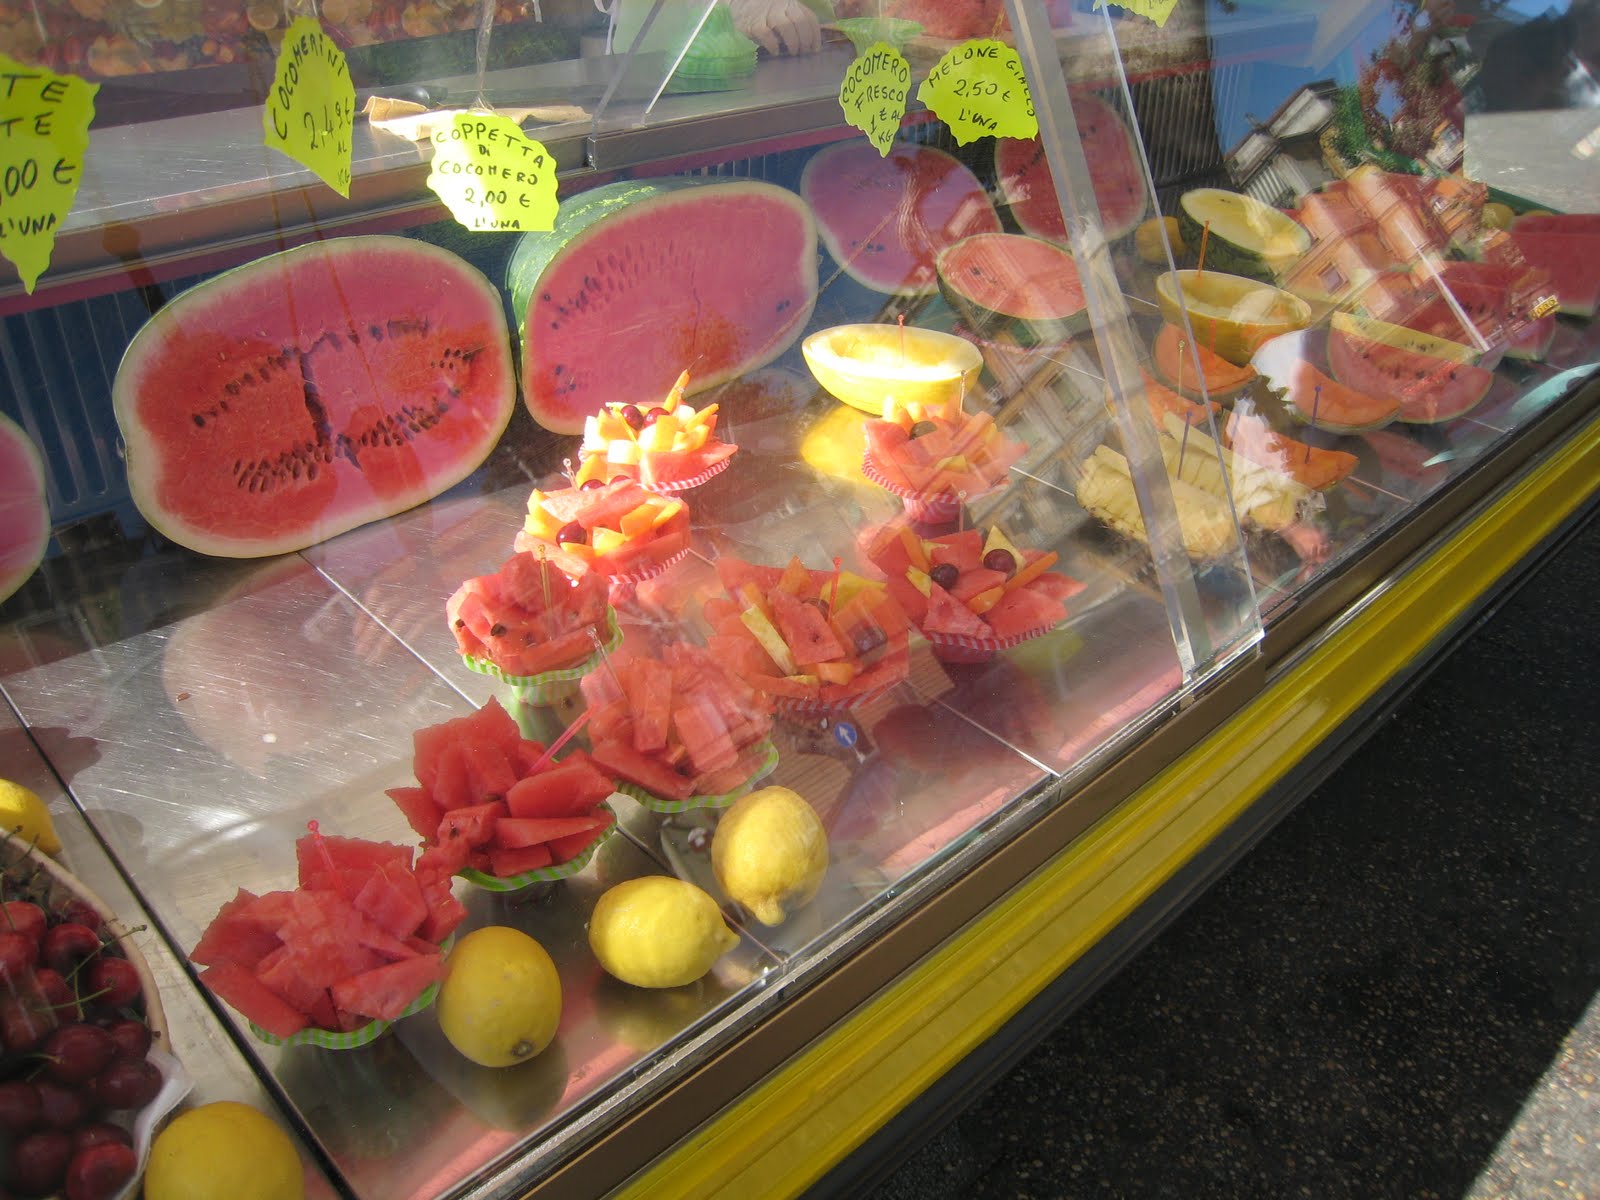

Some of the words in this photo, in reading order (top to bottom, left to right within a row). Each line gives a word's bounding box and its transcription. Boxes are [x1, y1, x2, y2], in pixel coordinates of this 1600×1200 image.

[842, 51, 908, 104] COCOMERO
[928, 45, 999, 88] MELONE
[854, 84, 904, 113] FRESCO
[953, 78, 998, 98] 2,50
[958, 107, 998, 131] L'UNA
[436, 122, 544, 169] COPPETTA
[878, 129, 894, 144] KG
[464, 187, 507, 208] 2,00
[518, 193, 531, 208] €
[474, 216, 521, 230] L'UNA
